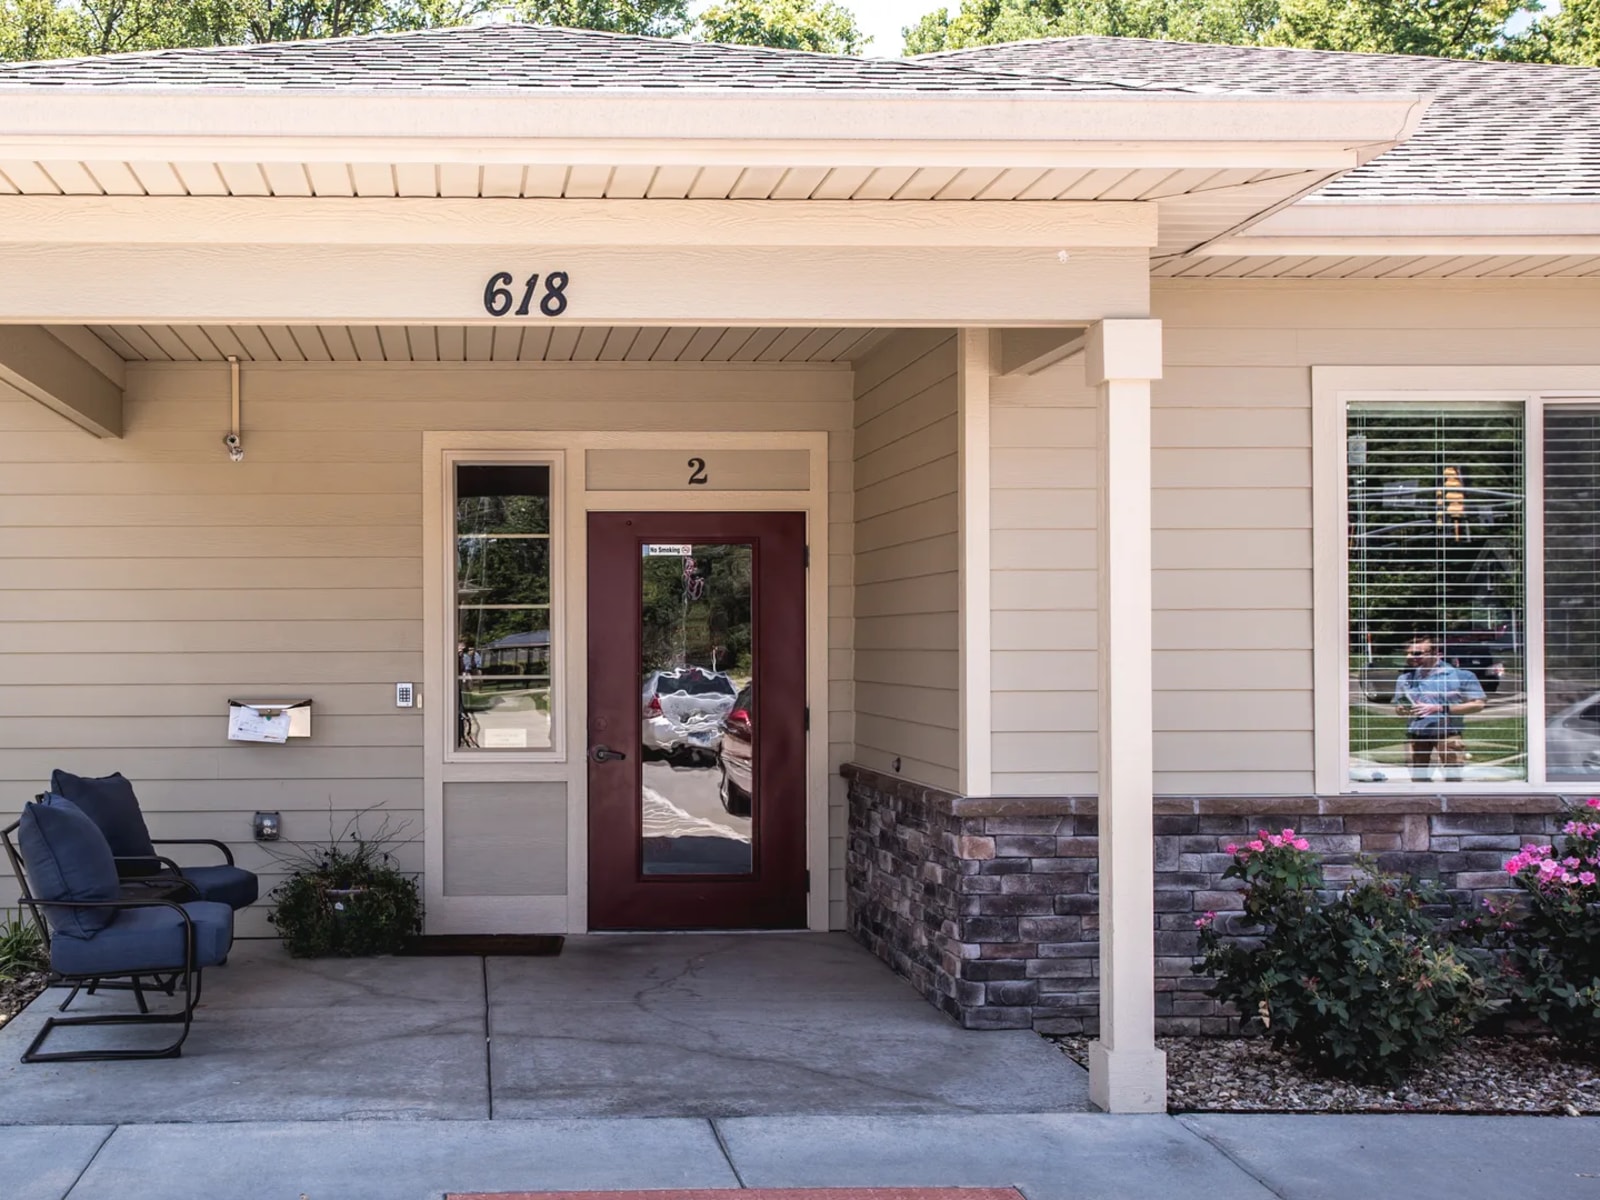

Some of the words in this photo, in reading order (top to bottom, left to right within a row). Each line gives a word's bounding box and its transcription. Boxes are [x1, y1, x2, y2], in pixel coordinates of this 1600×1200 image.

[484, 271, 569, 317] 618
[687, 457, 708, 485] 2
[658, 546, 680, 555] Smoking
